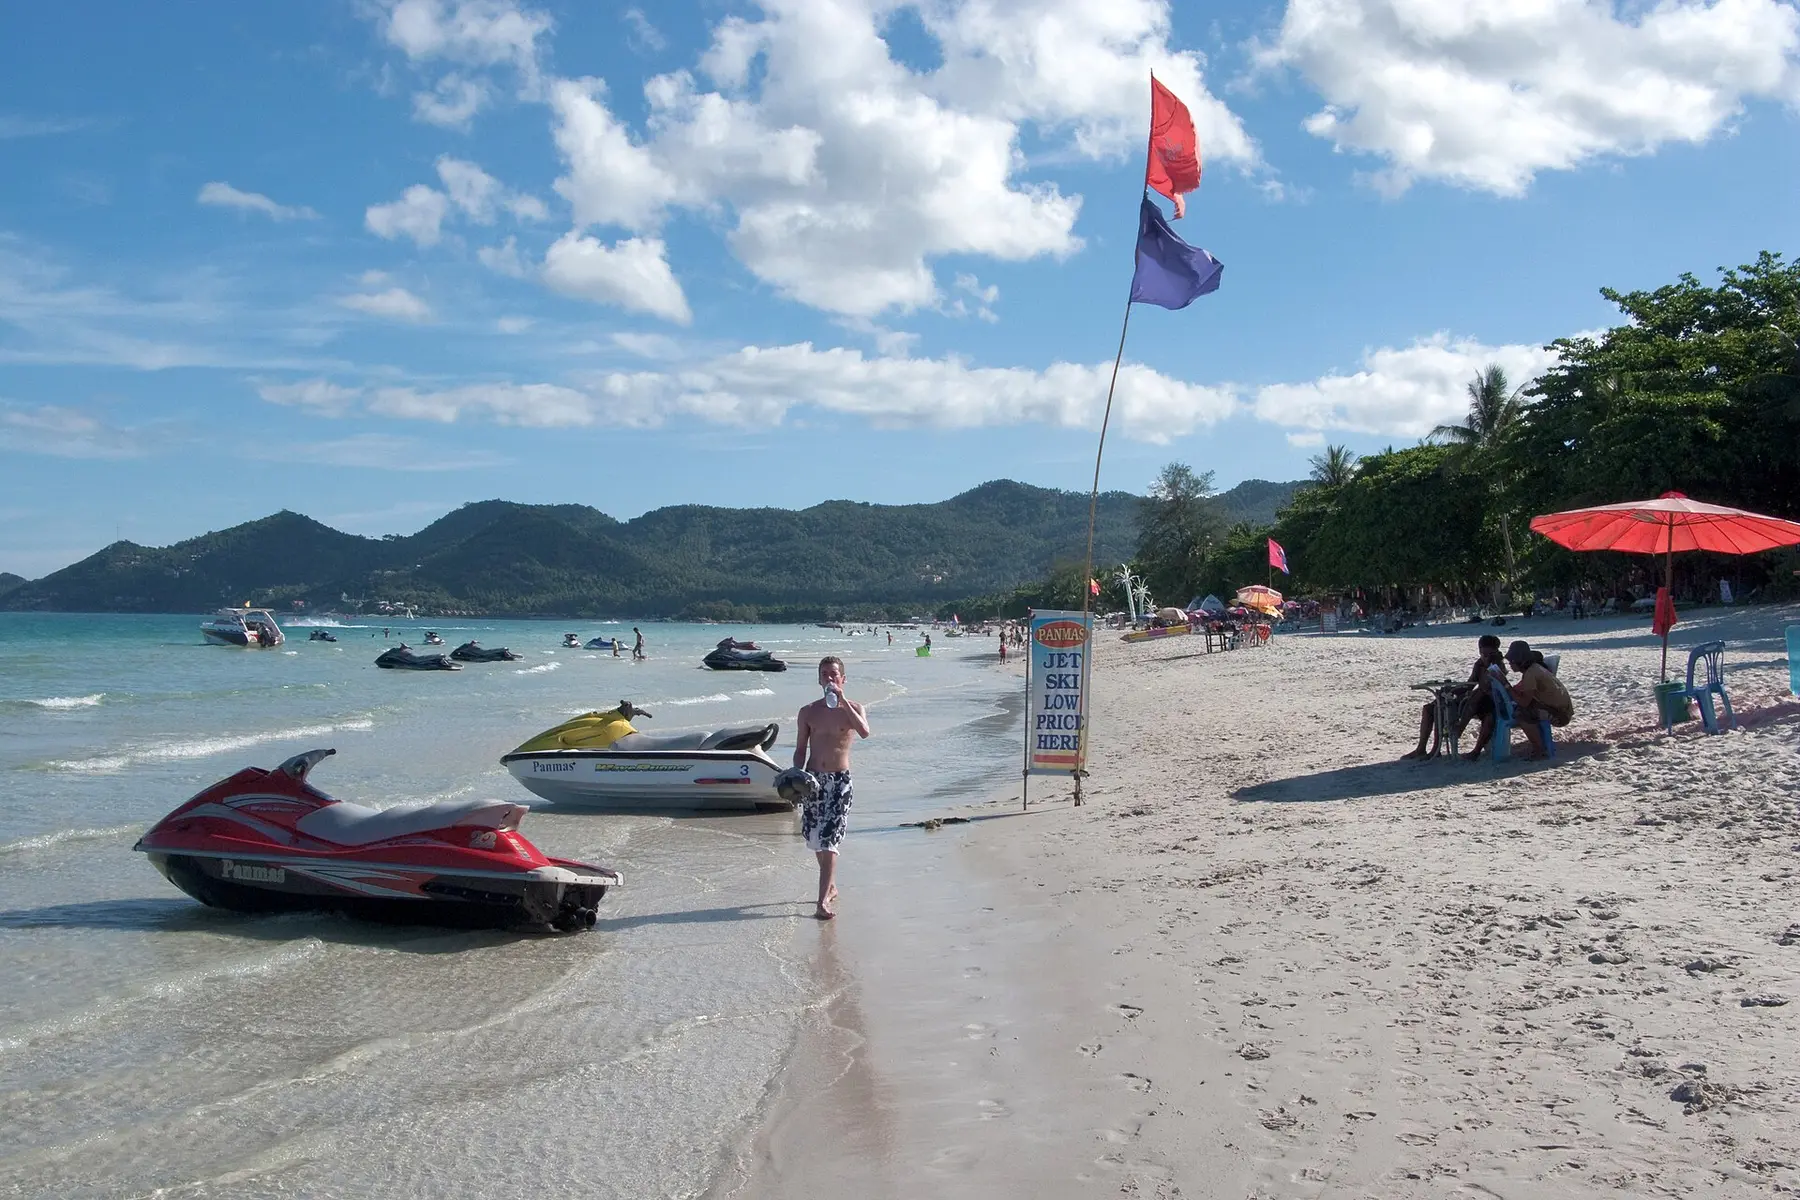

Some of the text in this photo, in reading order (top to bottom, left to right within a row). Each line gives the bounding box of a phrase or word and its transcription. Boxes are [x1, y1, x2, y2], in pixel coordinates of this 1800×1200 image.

[1038, 628, 1085, 641] PANMAS
[1043, 653, 1081, 668] JET
[1045, 674, 1079, 690] SKI
[1044, 694, 1079, 710] LOW
[532, 761, 575, 772] Panmas
[740, 765, 749, 776] 3
[221, 859, 285, 883] Panmas
